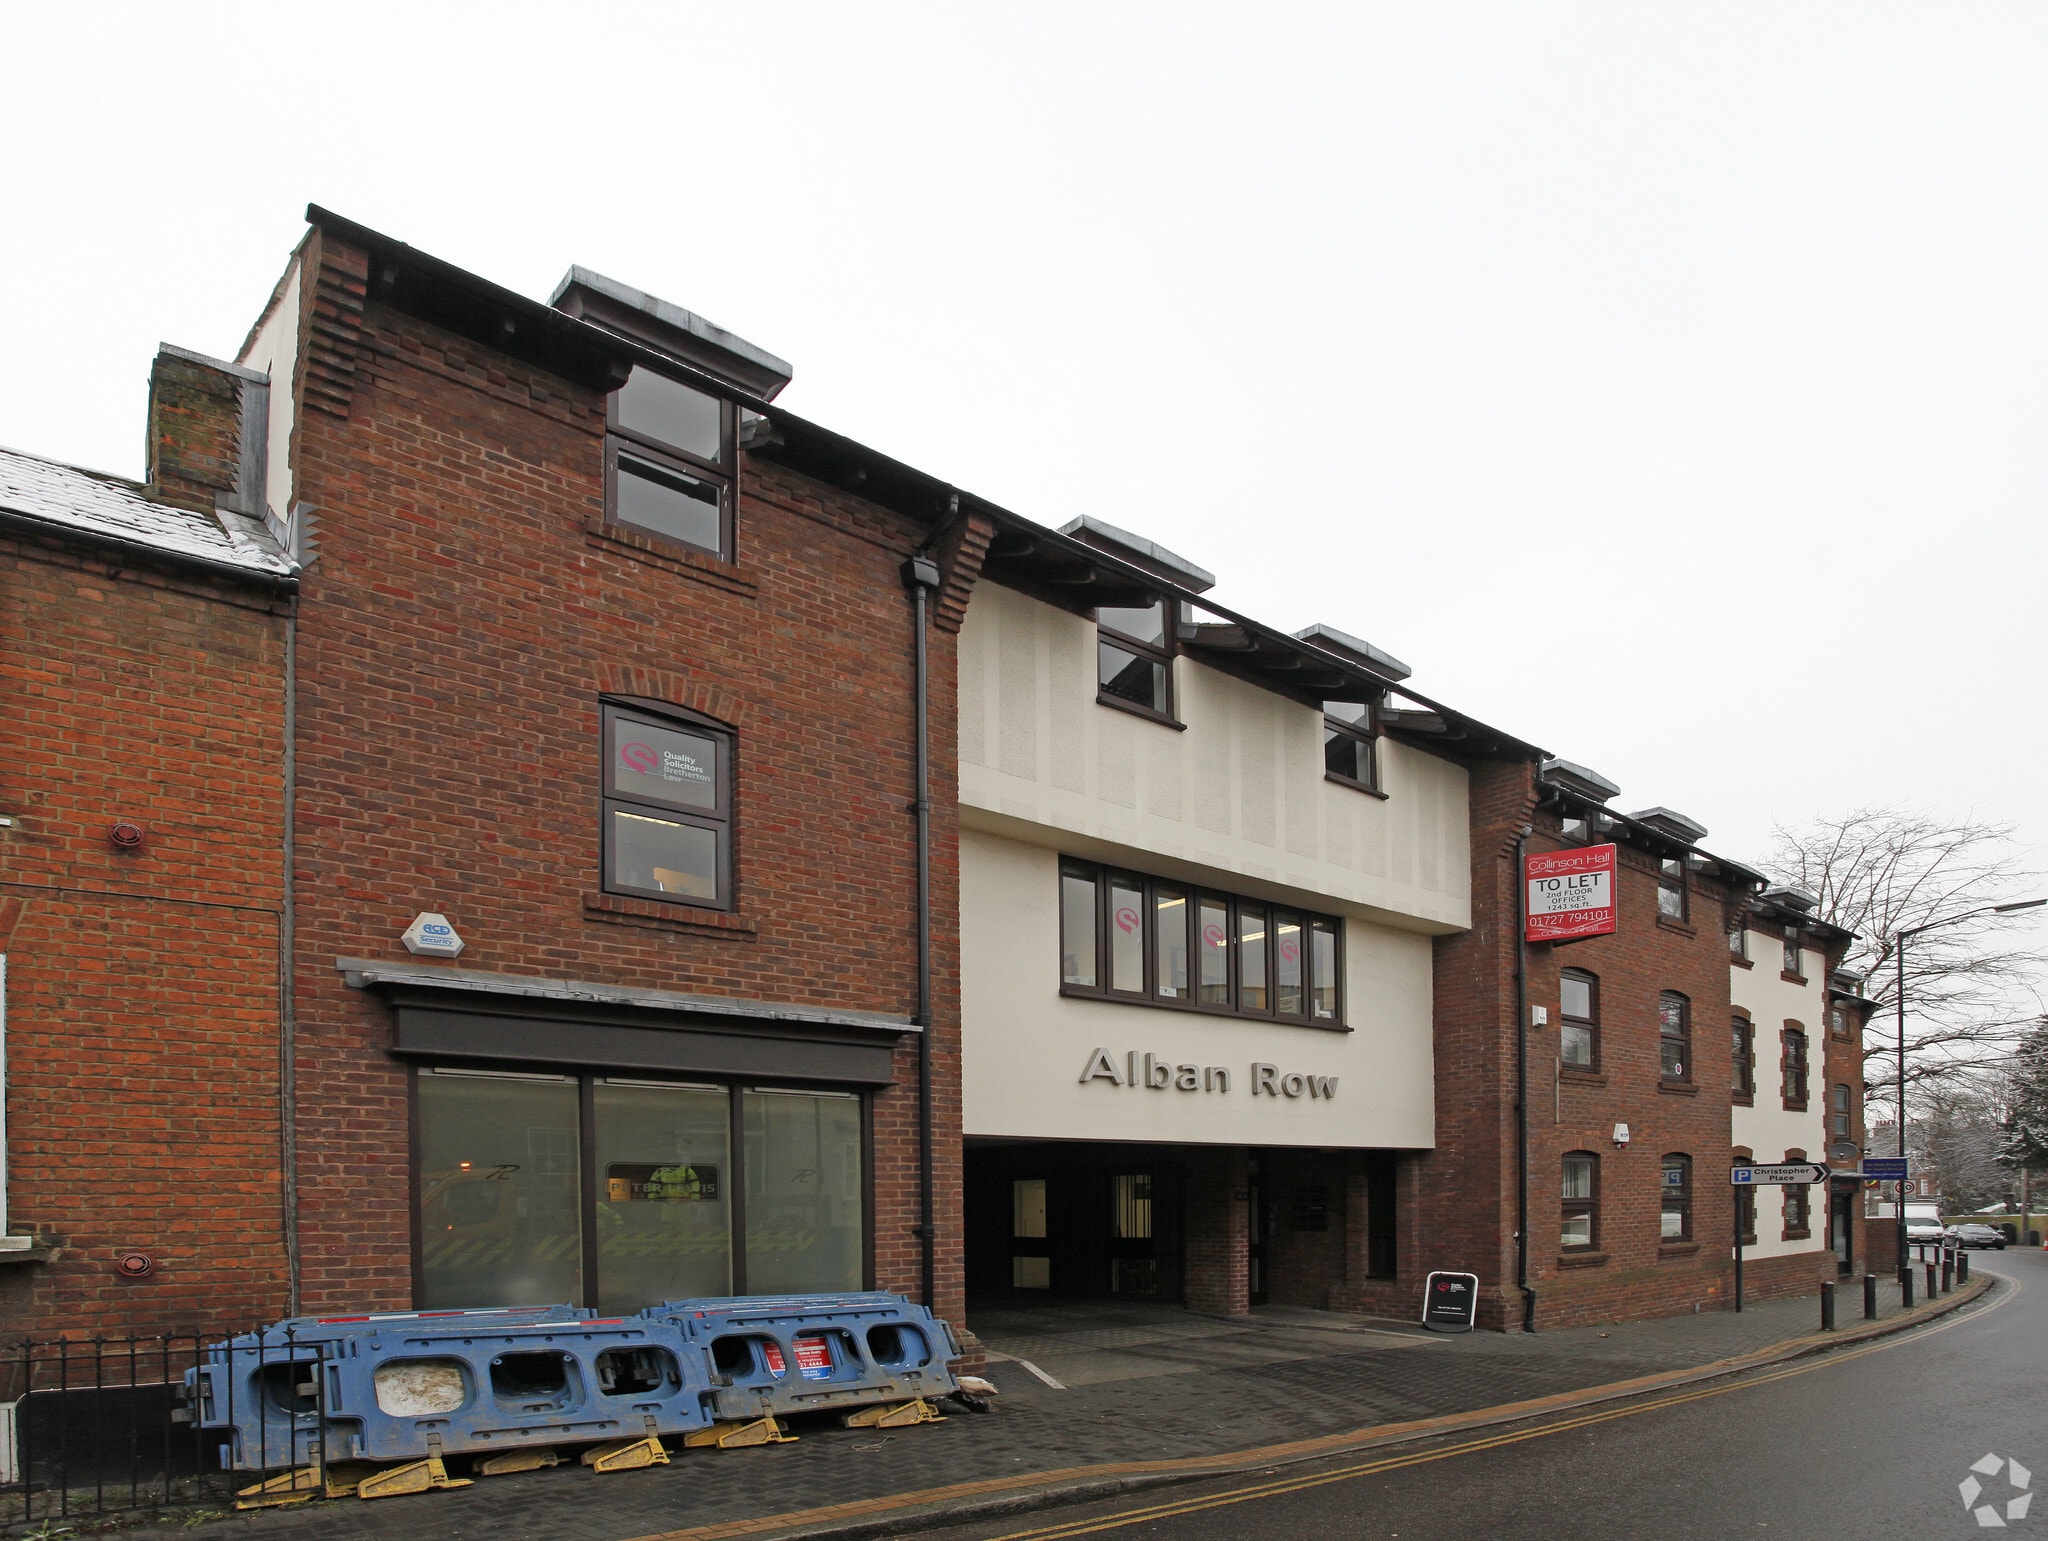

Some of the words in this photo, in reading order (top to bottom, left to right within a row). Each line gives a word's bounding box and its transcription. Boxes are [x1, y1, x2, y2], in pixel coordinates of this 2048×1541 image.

[663, 750, 696, 766] Quality
[663, 758, 704, 774] Solicitors
[663, 765, 711, 782] Bretherton
[663, 772, 682, 782] Law
[1528, 856, 1583, 872] Collinson
[1586, 851, 1610, 865] Hall
[1536, 878, 1561, 892] TO
[1568, 872, 1602, 889] LET
[1546, 891, 1562, 899] 2nd
[1564, 887, 1593, 896] FLOOR
[1551, 895, 1586, 904] OFFICES
[1547, 903, 1568, 911] 1243
[1529, 913, 1565, 927] 01727
[1567, 909, 1609, 923] 794101
[1078, 1046, 1232, 1092] Alban
[1251, 1061, 1340, 1101] Row
[1753, 1166, 1810, 1176] Christopher
